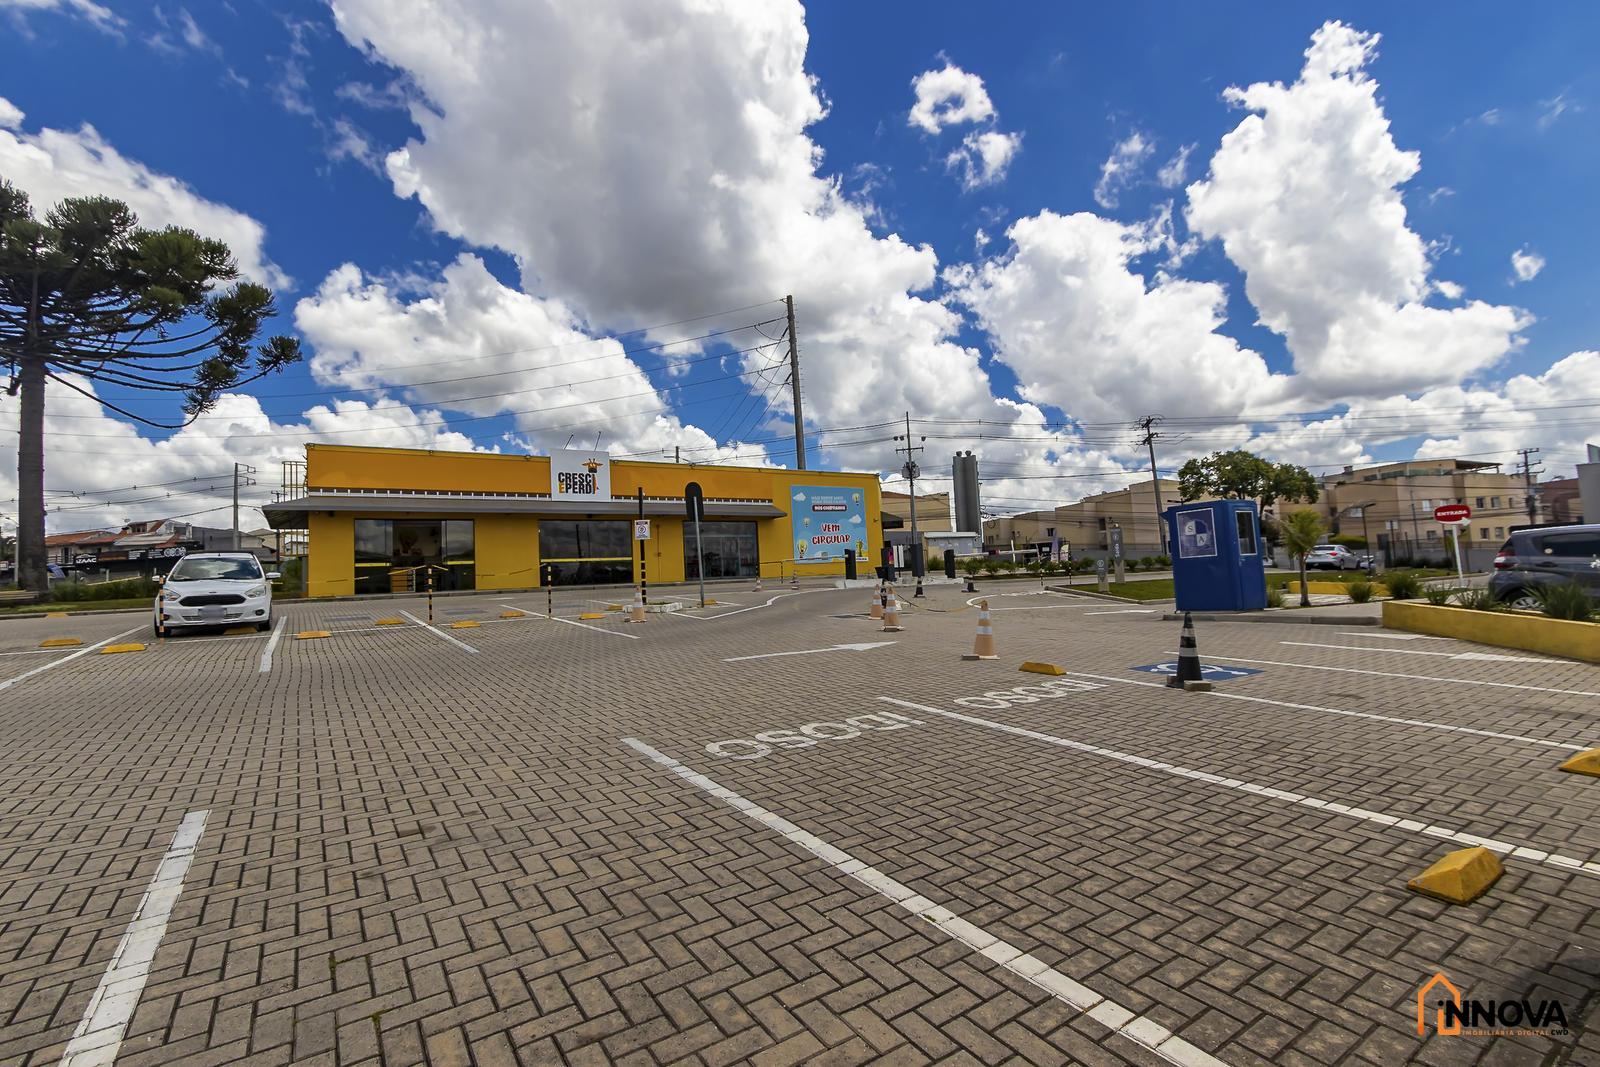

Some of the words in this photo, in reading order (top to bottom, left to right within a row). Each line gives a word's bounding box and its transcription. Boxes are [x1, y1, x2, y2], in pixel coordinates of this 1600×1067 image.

[822, 524, 840, 532] VEM
[812, 534, 850, 544] CIRCULAR
[705, 711, 927, 760] IDOSO
